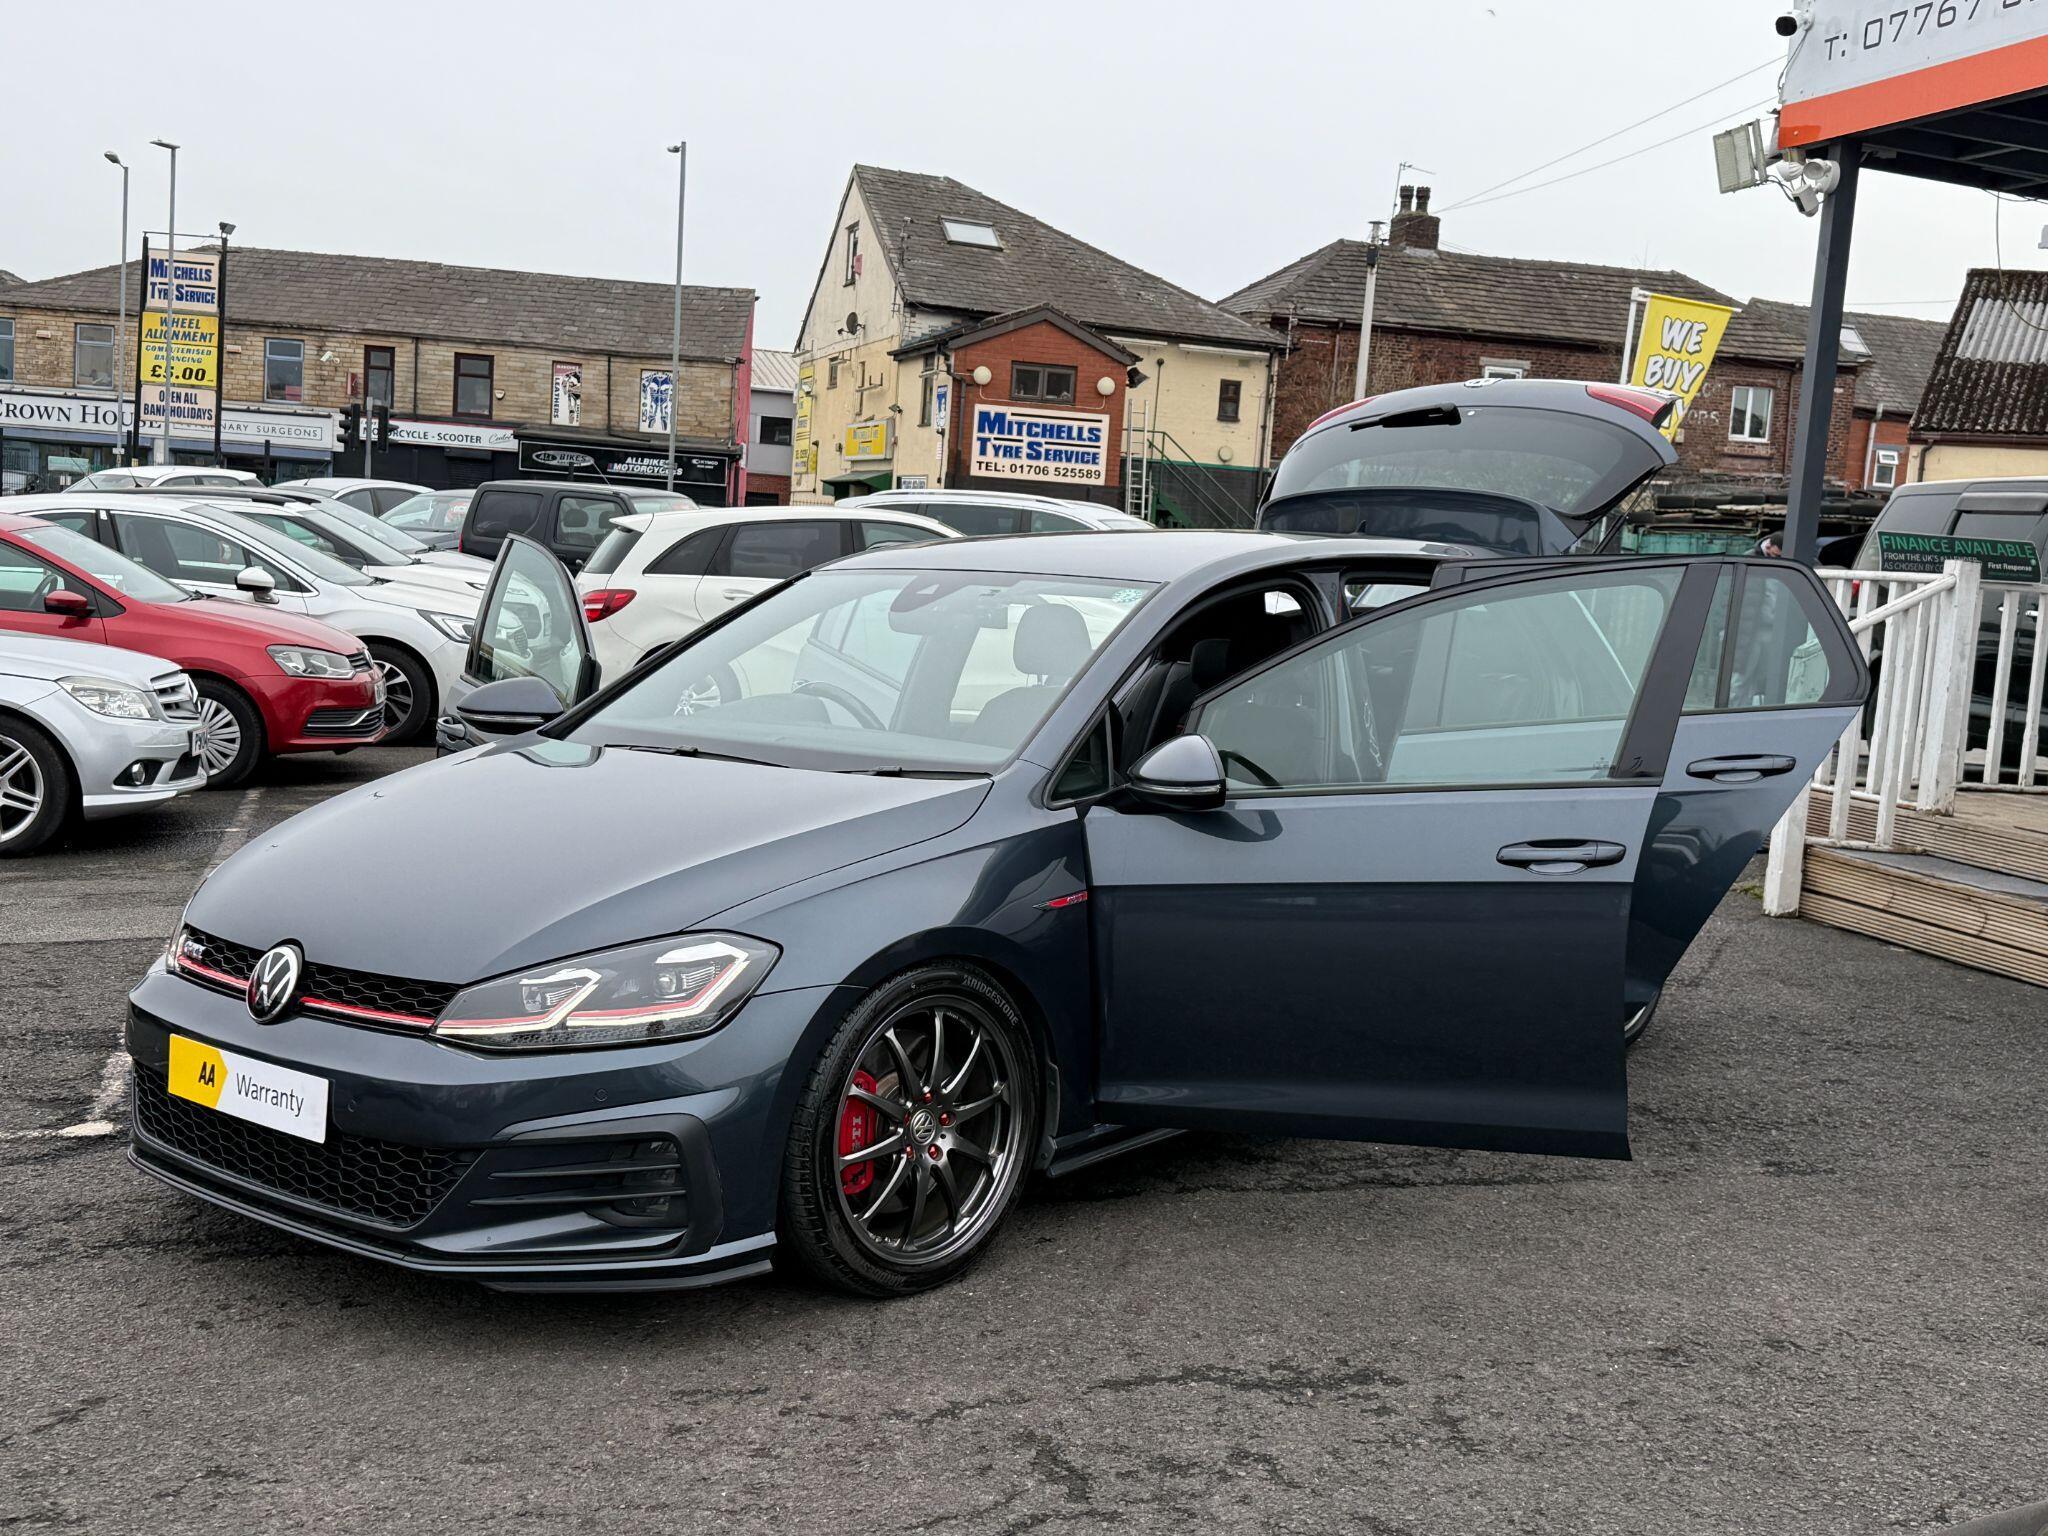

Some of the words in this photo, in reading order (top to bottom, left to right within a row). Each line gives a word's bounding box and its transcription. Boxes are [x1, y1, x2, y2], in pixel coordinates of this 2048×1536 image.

[1863, 0, 1981, 50] 07767
[150, 258, 213, 282] MICHELLS
[149, 282, 173, 301] TYR
[175, 283, 216, 305] SERVICE
[1661, 315, 1708, 355] WE
[145, 344, 212, 356] COMUTERISED
[154, 354, 203, 364] BAANCING
[1643, 354, 1705, 394] BUY
[159, 390, 182, 403] OEN
[183, 392, 198, 405] ALL
[0, 400, 72, 422] ROWN
[170, 405, 213, 421] HOLIDAYS
[256, 425, 318, 437] SURGEONS
[976, 410, 1103, 443] MITCHELLS
[437, 432, 482, 444] SCOOTER
[559, 453, 588, 462] BIKES
[976, 436, 1023, 459] TYRE
[1026, 441, 1100, 465] SERVICE
[976, 460, 1005, 473] TEL:
[1010, 463, 1050, 477] 01706
[1054, 466, 1101, 480] 525589
[1881, 535, 1951, 553] FINANCE
[1954, 540, 2035, 559] AVAILABLE
[1883, 552, 1905, 561] FROM
[1905, 553, 1921, 562] THE
[1922, 554, 1939, 562] UK'S
[1883, 562, 1893, 570] AS
[1893, 562, 1923, 571] CHOSEN
[1924, 563, 1934, 571] BY
[1987, 561, 2002, 570] First
[2003, 563, 2033, 572] Response
[198, 1061, 216, 1088] AA
[236, 1073, 304, 1117] Warranty
